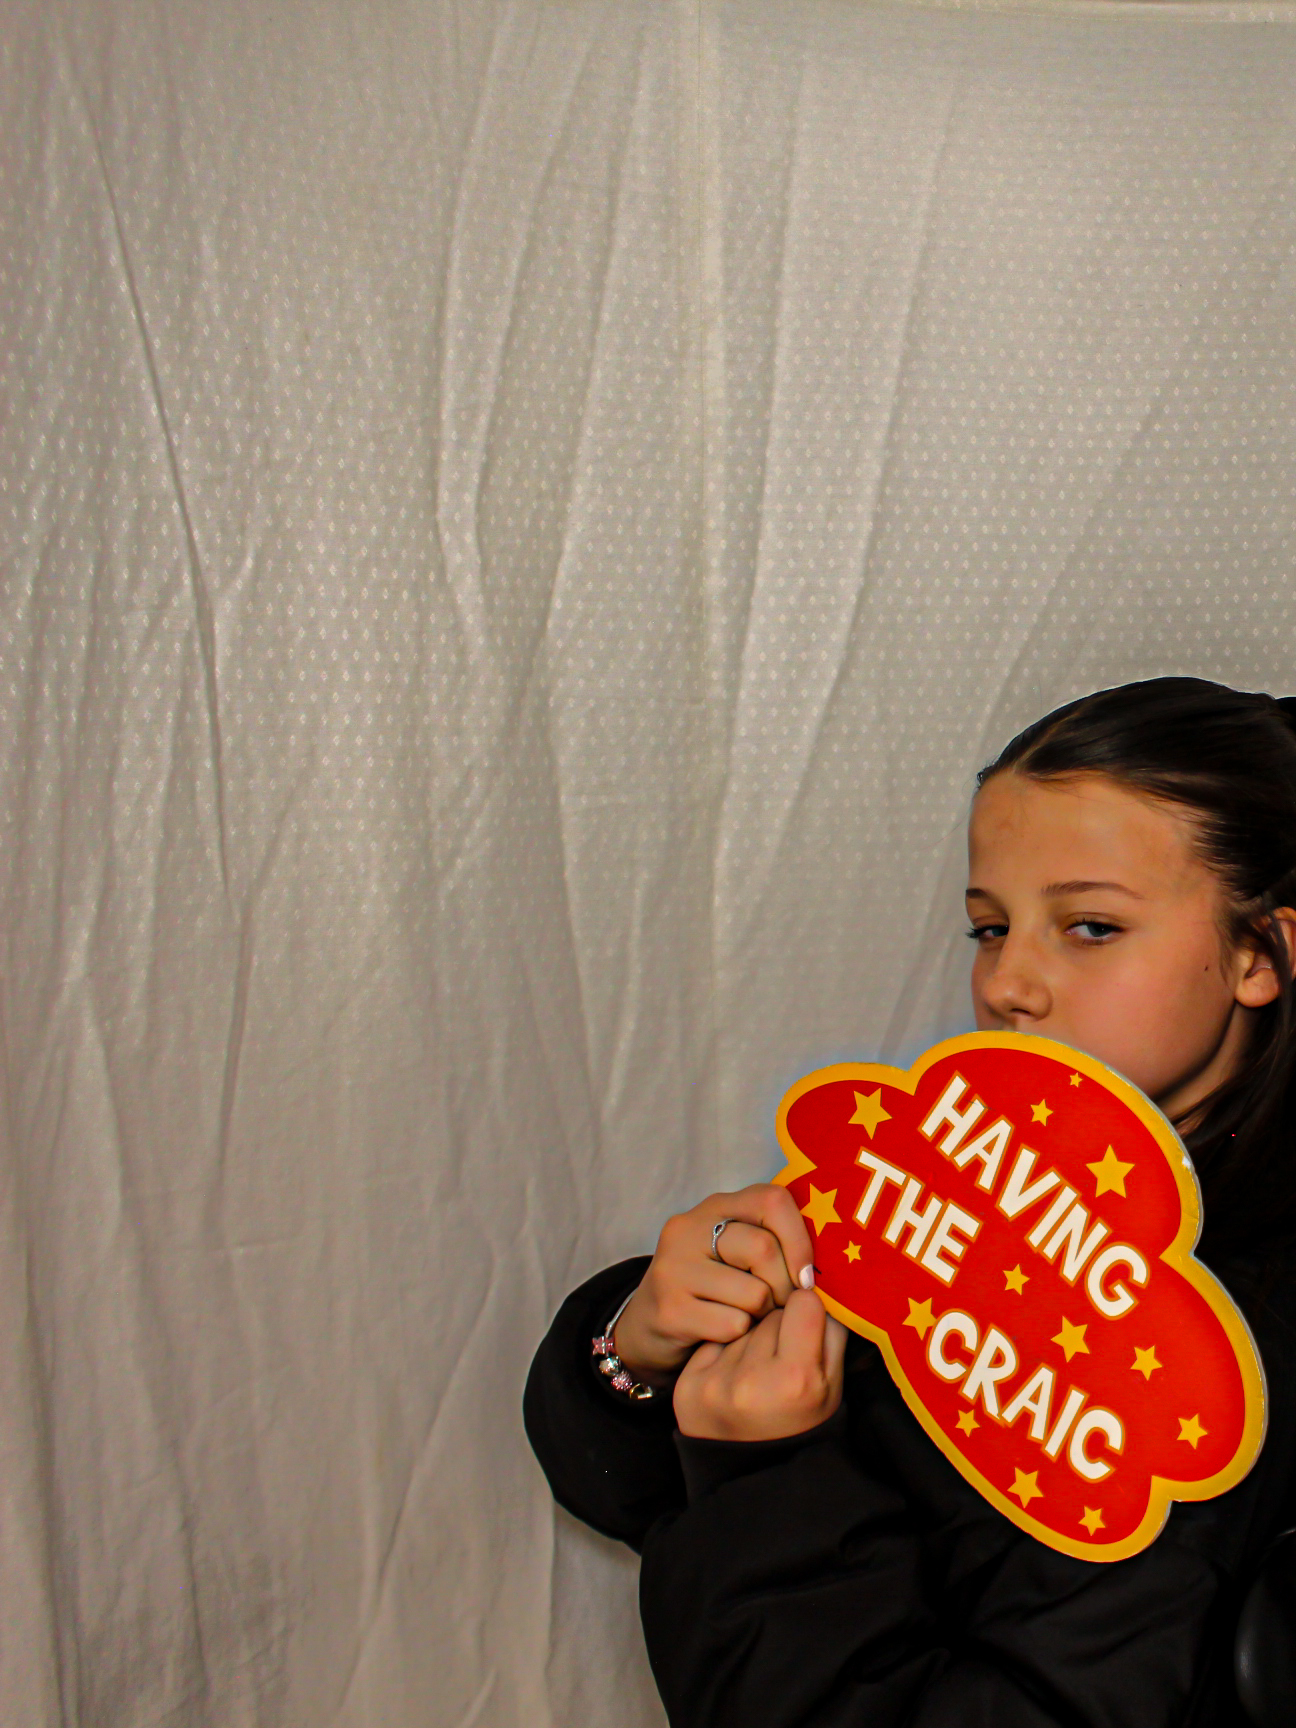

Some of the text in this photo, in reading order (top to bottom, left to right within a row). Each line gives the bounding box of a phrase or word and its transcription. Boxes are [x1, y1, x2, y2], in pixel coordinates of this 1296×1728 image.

[855, 1149, 981, 1284] THE
[921, 1074, 1149, 1318] HAVING
[927, 1310, 1125, 1481] CRAIC
